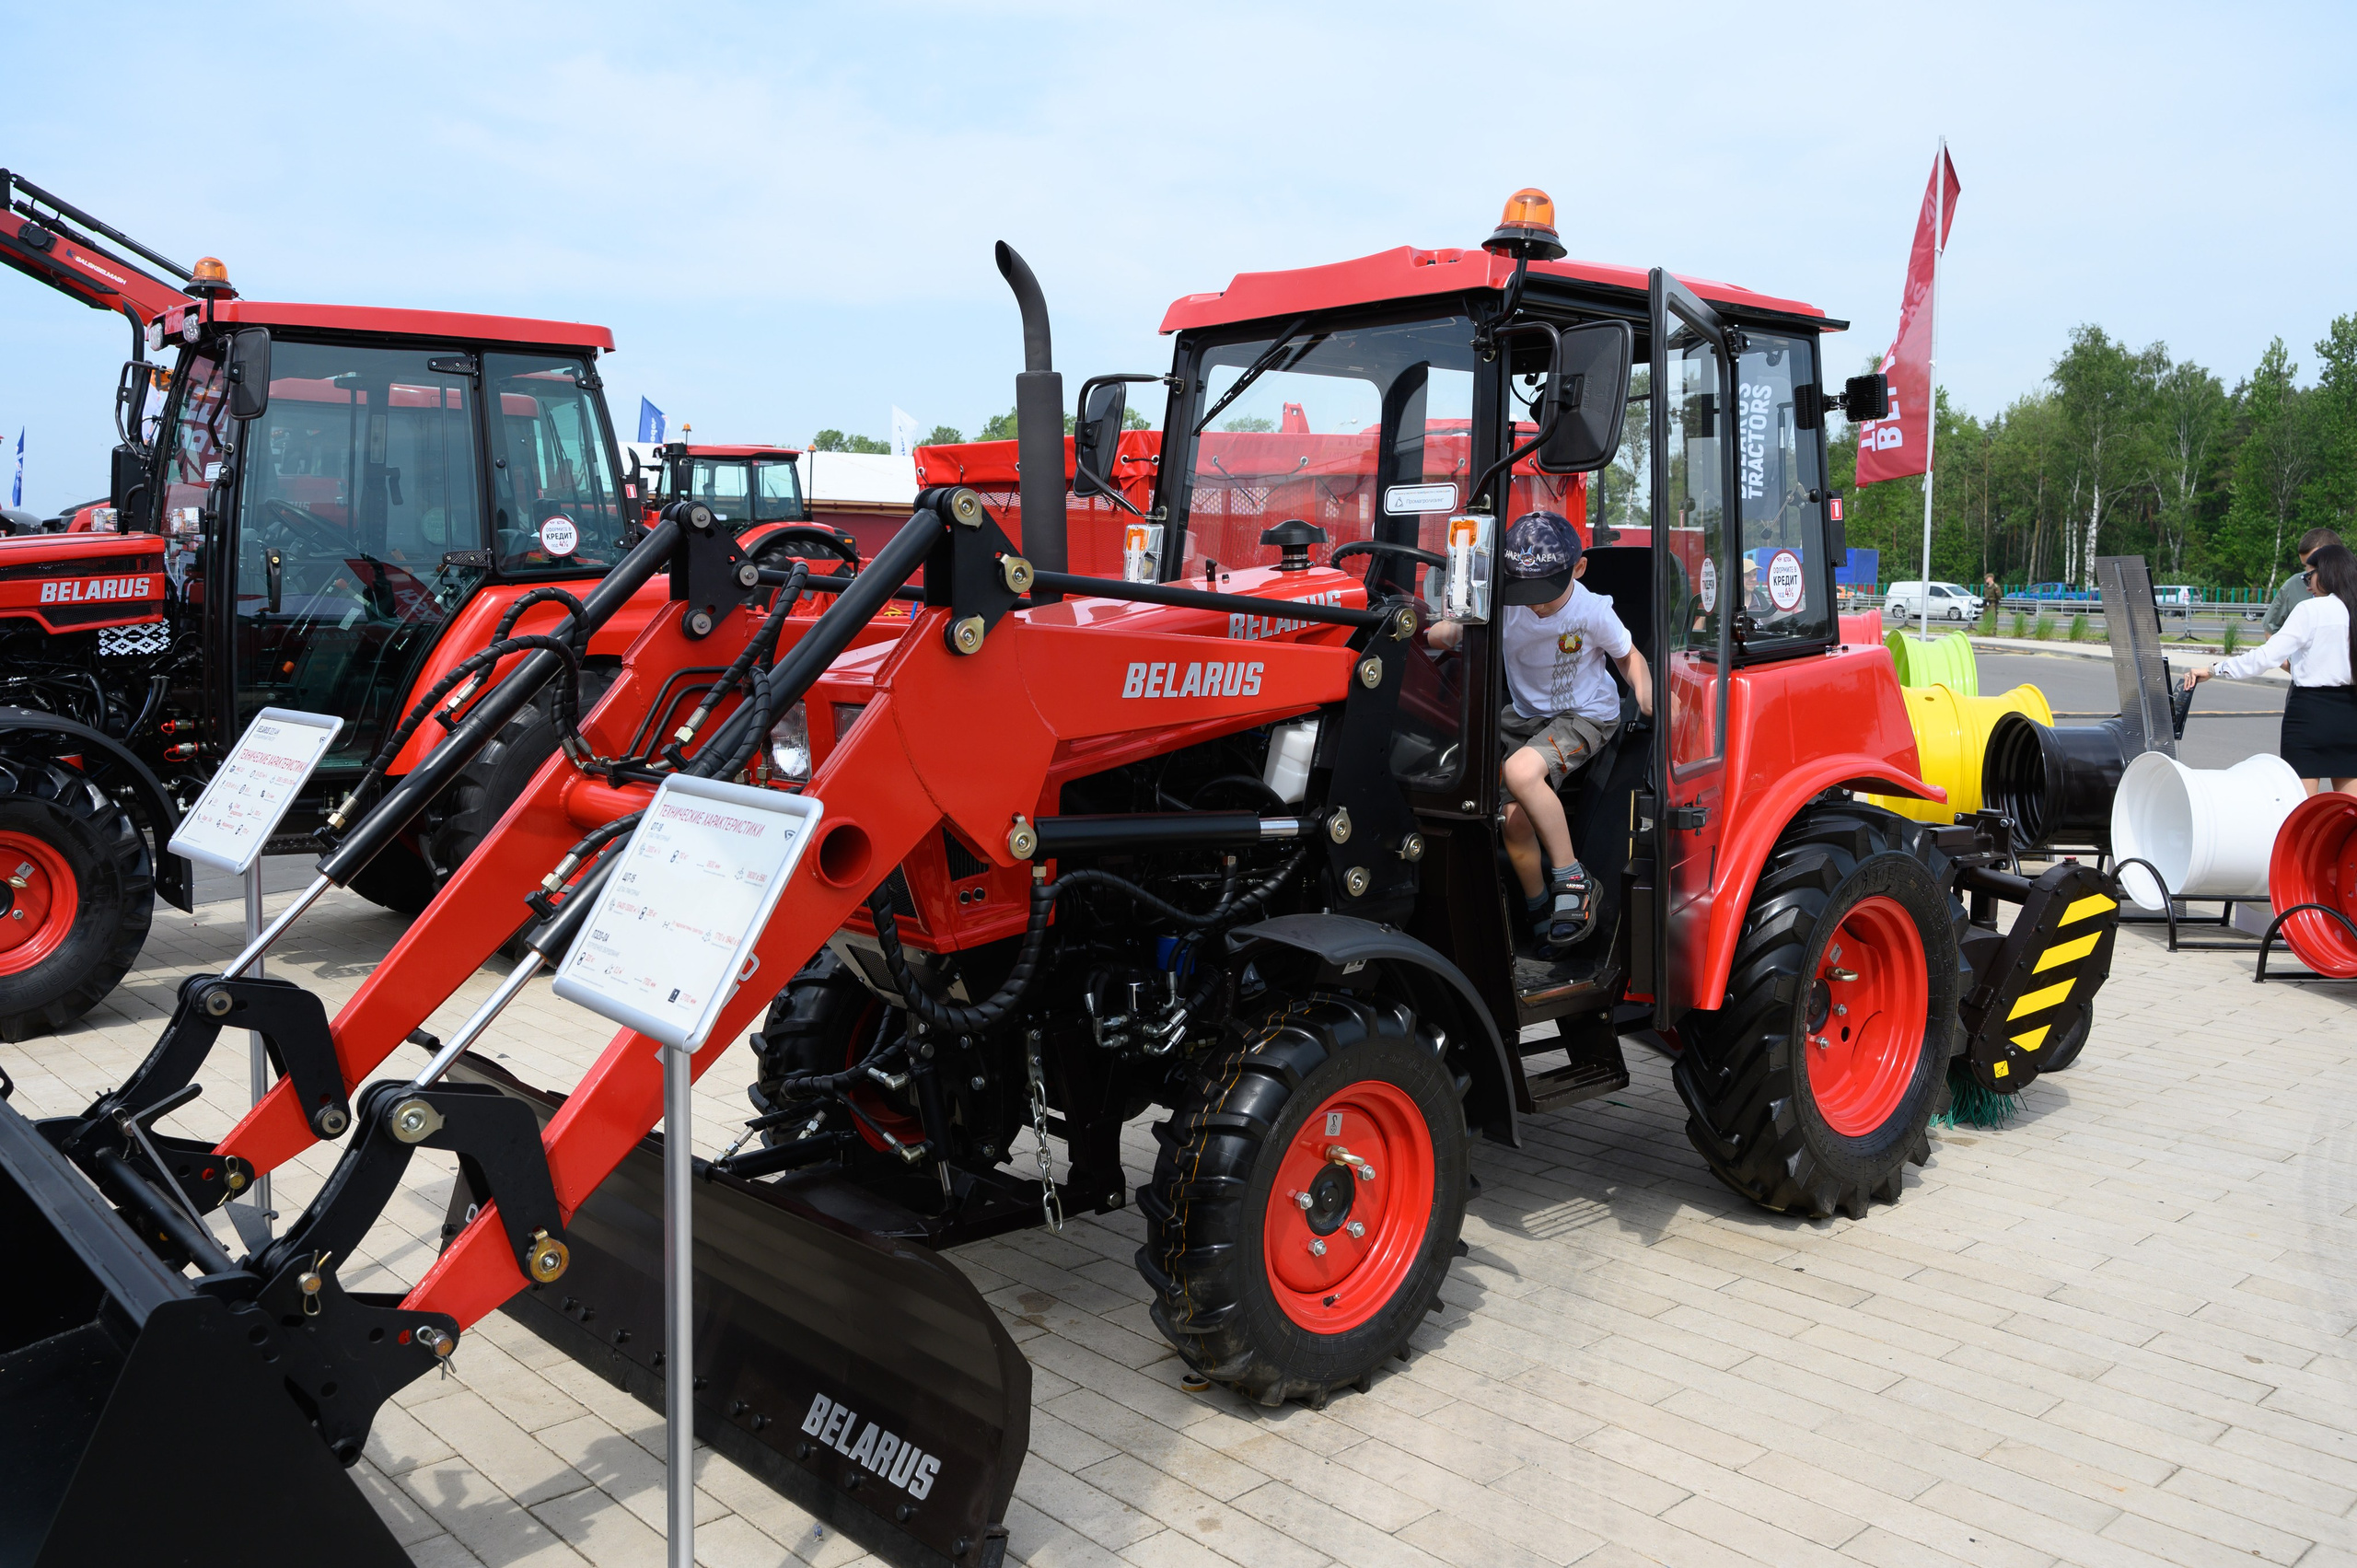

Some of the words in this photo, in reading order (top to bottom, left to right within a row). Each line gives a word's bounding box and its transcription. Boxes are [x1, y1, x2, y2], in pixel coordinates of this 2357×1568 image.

[1747, 384, 1772, 499] TRACTORS
[546, 532, 572, 540] КРЕДИТ
[1536, 552, 1556, 563] AREA
[41, 577, 150, 603] BELARUS
[1773, 575, 1797, 587] КРЕДИТ
[1121, 661, 1265, 699] BELARUS
[266, 754, 308, 773] ХАРАКТЕРИСТИК
[659, 804, 705, 825] ТЕХНИЧЕСКИЕ
[702, 812, 766, 838] ХАРАКТЕРИСТИКИ
[800, 1392, 942, 1500] BELARUS
